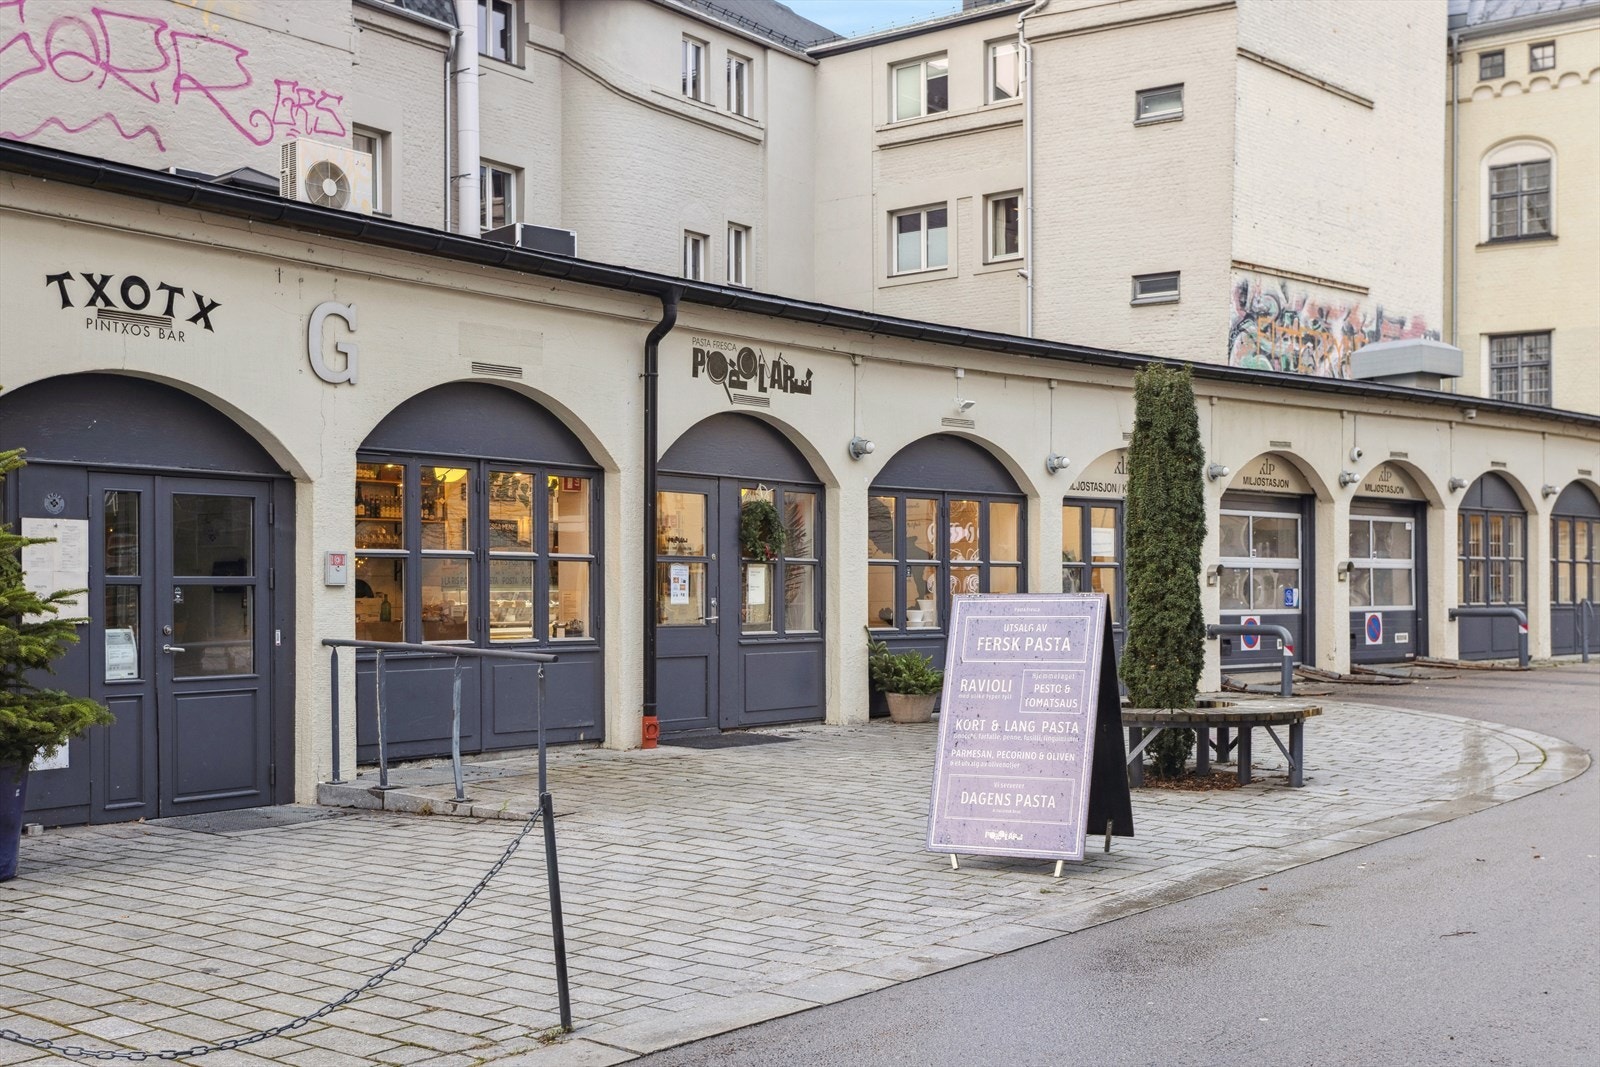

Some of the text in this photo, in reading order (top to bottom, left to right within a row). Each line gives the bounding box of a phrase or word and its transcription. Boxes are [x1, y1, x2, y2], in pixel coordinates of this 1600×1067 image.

[46, 271, 222, 333] TXOTX
[86, 318, 185, 342] PINTXOS BAR
[307, 301, 359, 386] G
[692, 336, 738, 352] PASTA FRESCA
[1003, 623, 1048, 633] UTSALG AV
[977, 636, 1071, 652] FERSK PASTA
[960, 679, 1012, 693] RAVIOLI
[1034, 683, 1071, 694] PESTO &
[1025, 698, 1078, 708] TOMATSAUS
[955, 719, 1079, 734] KORT & LANG PASTA
[951, 749, 1075, 761] PARMESAN, PECORINO & OLIVEN
[961, 791, 1056, 808] DAGENS PASTA
